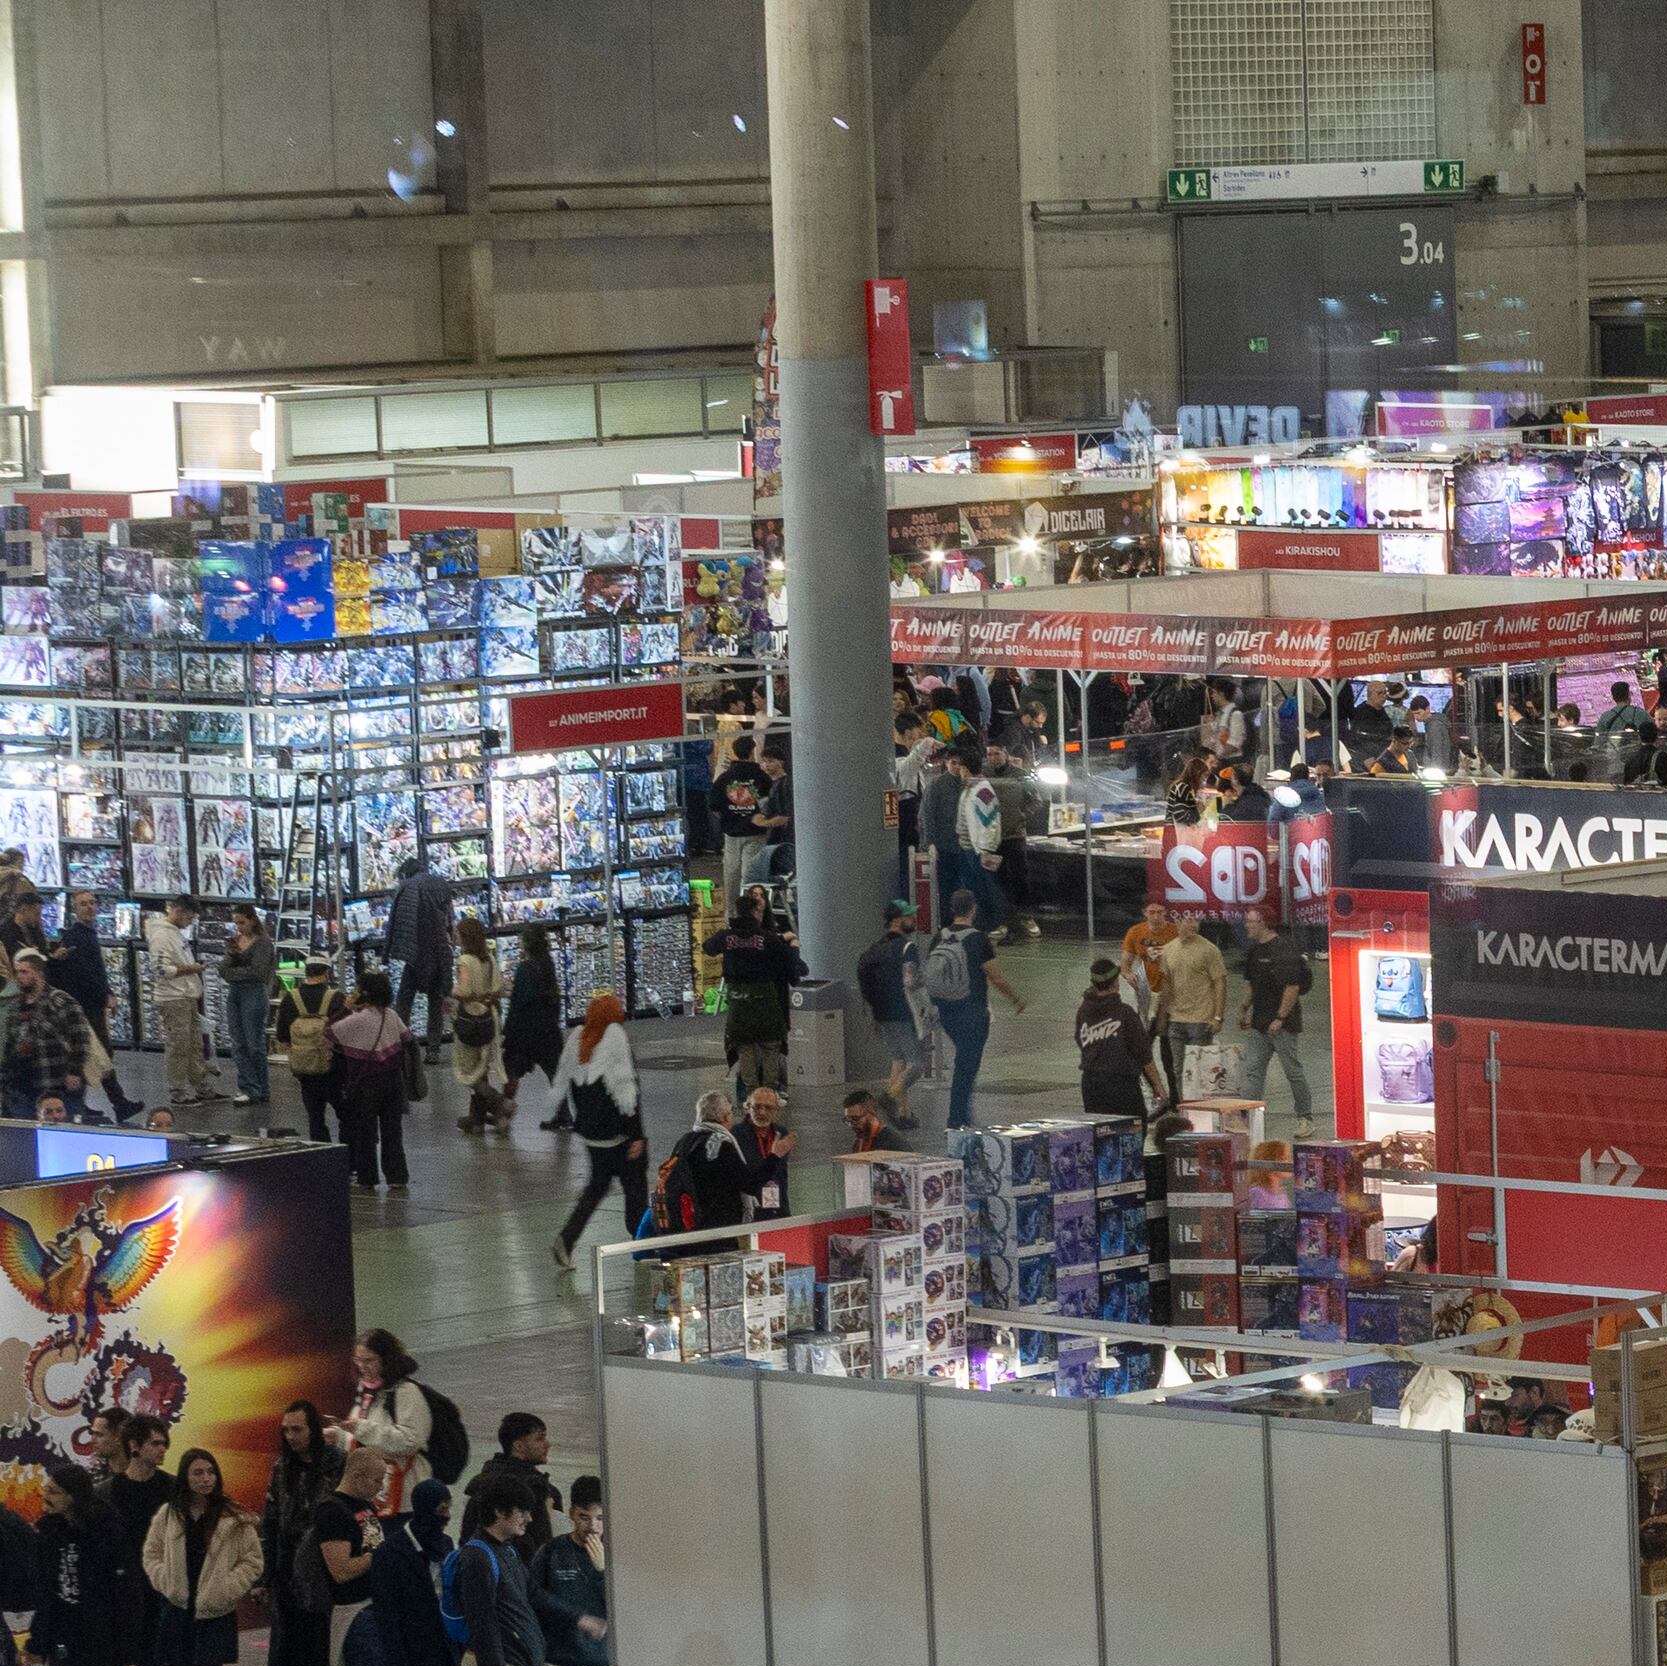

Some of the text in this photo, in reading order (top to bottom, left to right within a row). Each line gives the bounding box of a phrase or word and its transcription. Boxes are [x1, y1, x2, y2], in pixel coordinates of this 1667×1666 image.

[1400, 223, 1444, 265] 3.04
[907, 616, 961, 639] ANIME
[1443, 615, 1541, 641] OUTLET ANIME
[1547, 606, 1643, 633] OUTLET ANIME
[969, 620, 1083, 643] OUTLET ANIME
[1091, 626, 1207, 647] OUTLET ANIME
[1215, 630, 1332, 651] OUTLET ANIME
[1336, 625, 1436, 652] OUTLET ANIME
[559, 706, 649, 727] ANIMEIMPORT.IT
